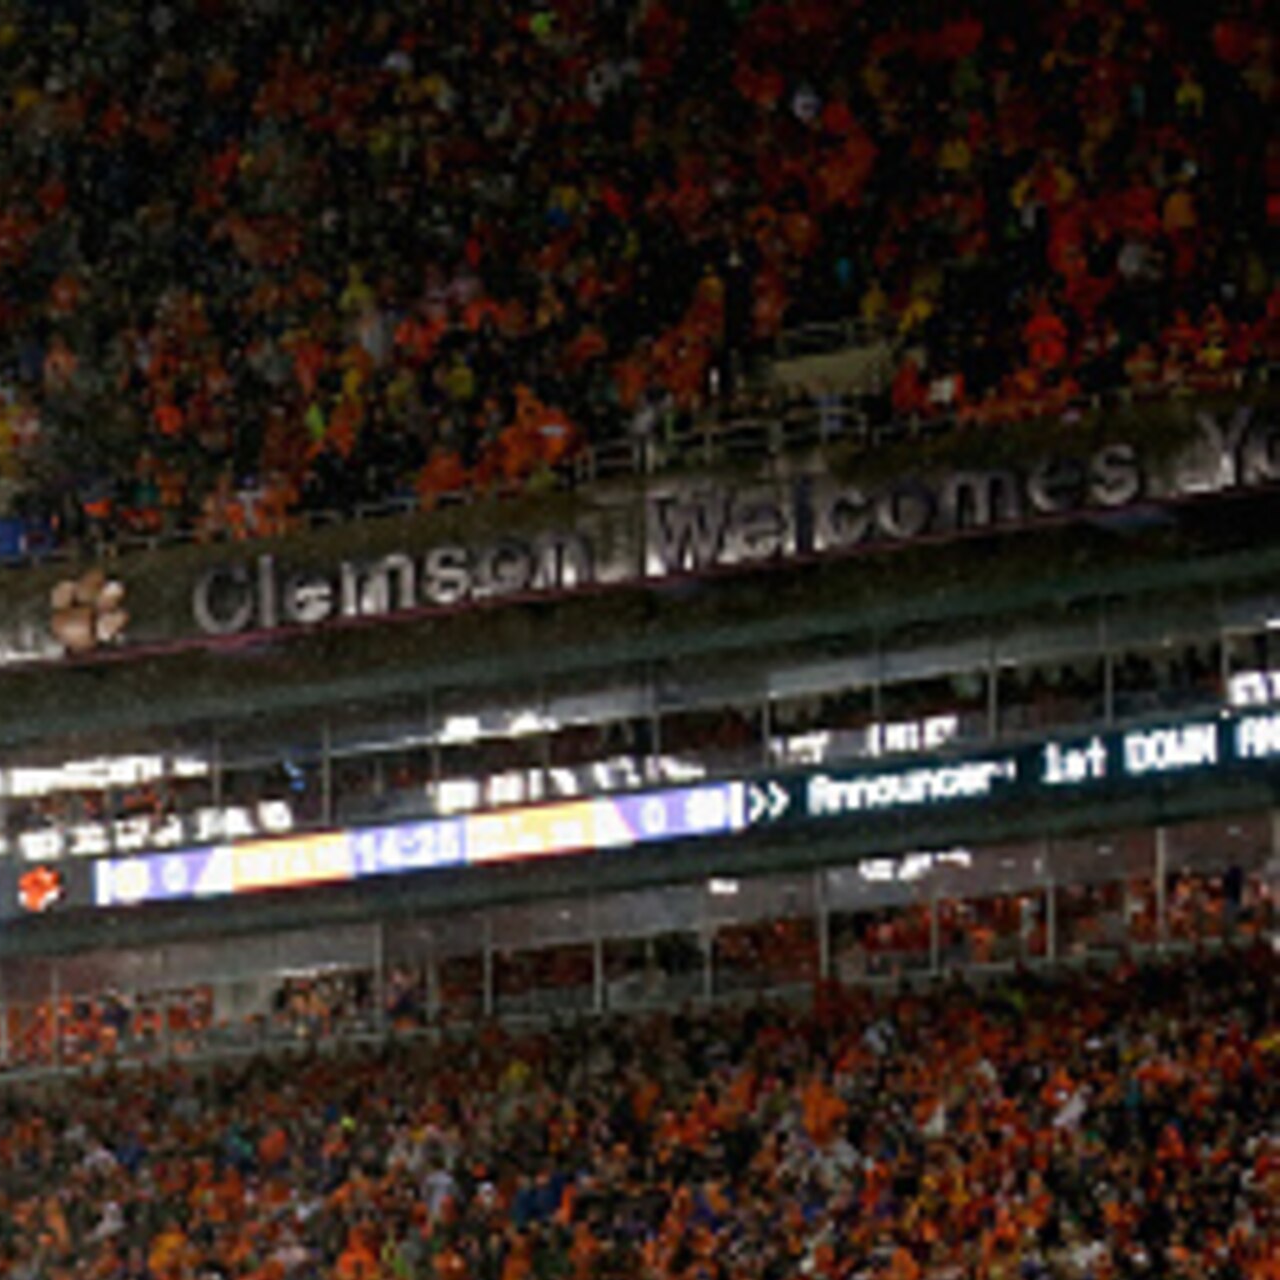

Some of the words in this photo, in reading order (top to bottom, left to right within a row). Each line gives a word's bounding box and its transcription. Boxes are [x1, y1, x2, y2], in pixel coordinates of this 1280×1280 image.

[192, 525, 597, 636] Clemson
[643, 443, 1138, 577] Welcomes
[1041, 734, 1107, 784] 1st
[1124, 722, 1219, 778] DOWN
